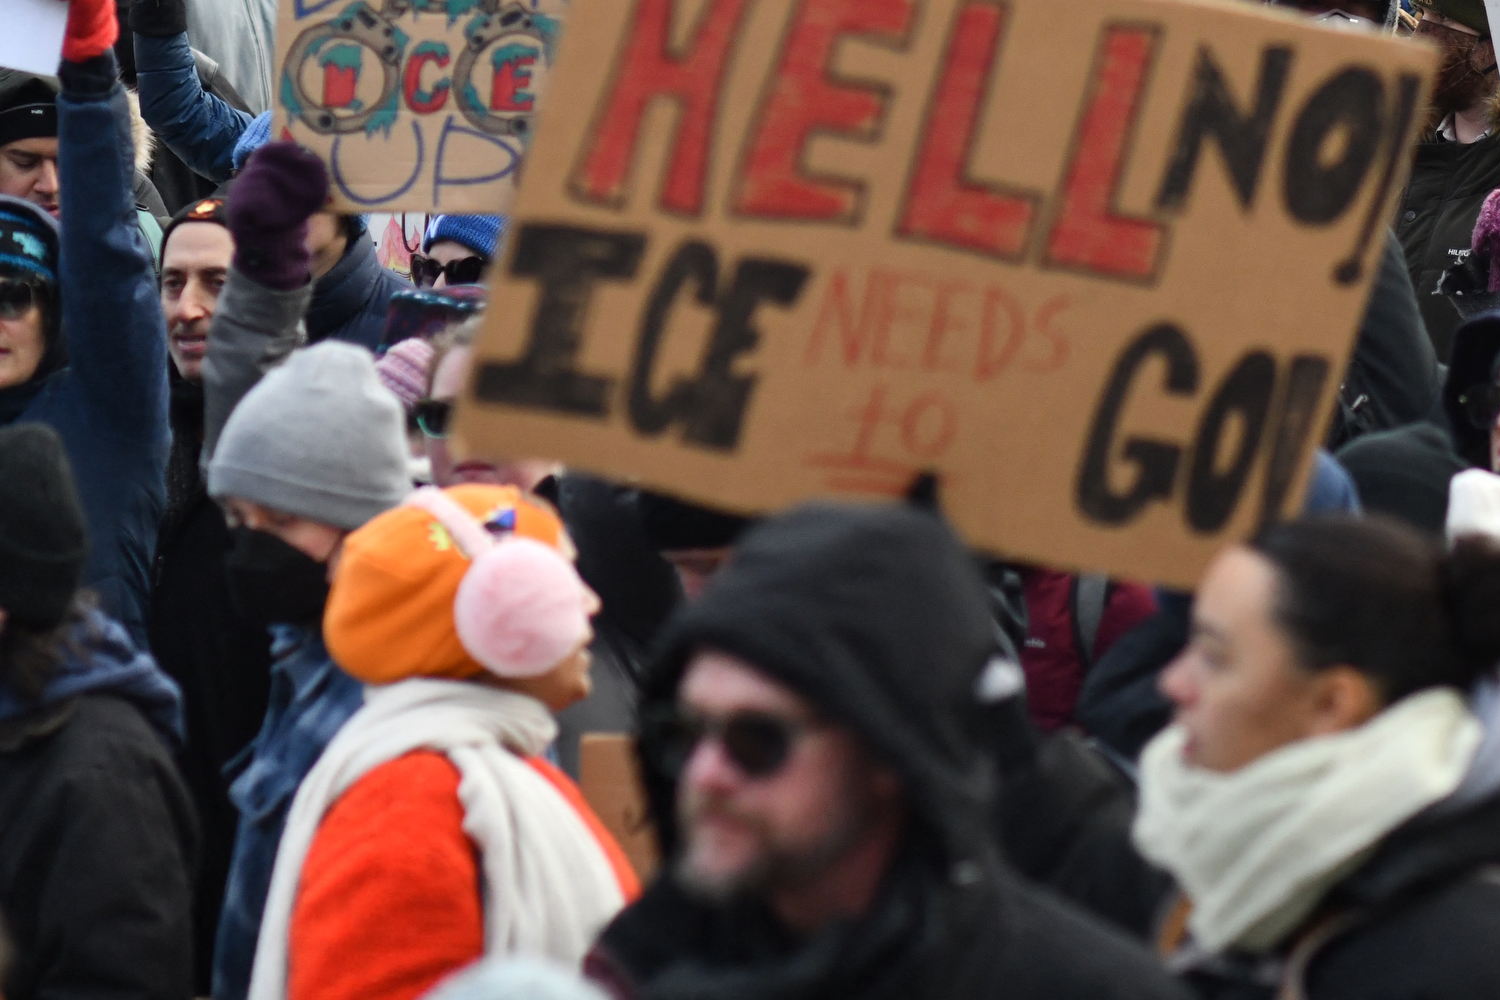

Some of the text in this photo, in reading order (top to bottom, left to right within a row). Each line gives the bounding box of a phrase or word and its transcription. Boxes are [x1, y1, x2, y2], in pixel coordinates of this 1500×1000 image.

[318, 40, 541, 115] ICE
[330, 115, 523, 208] UP
[1160, 43, 1423, 287] NO!
[475, 221, 1337, 535] ICE NEEDS GO!
